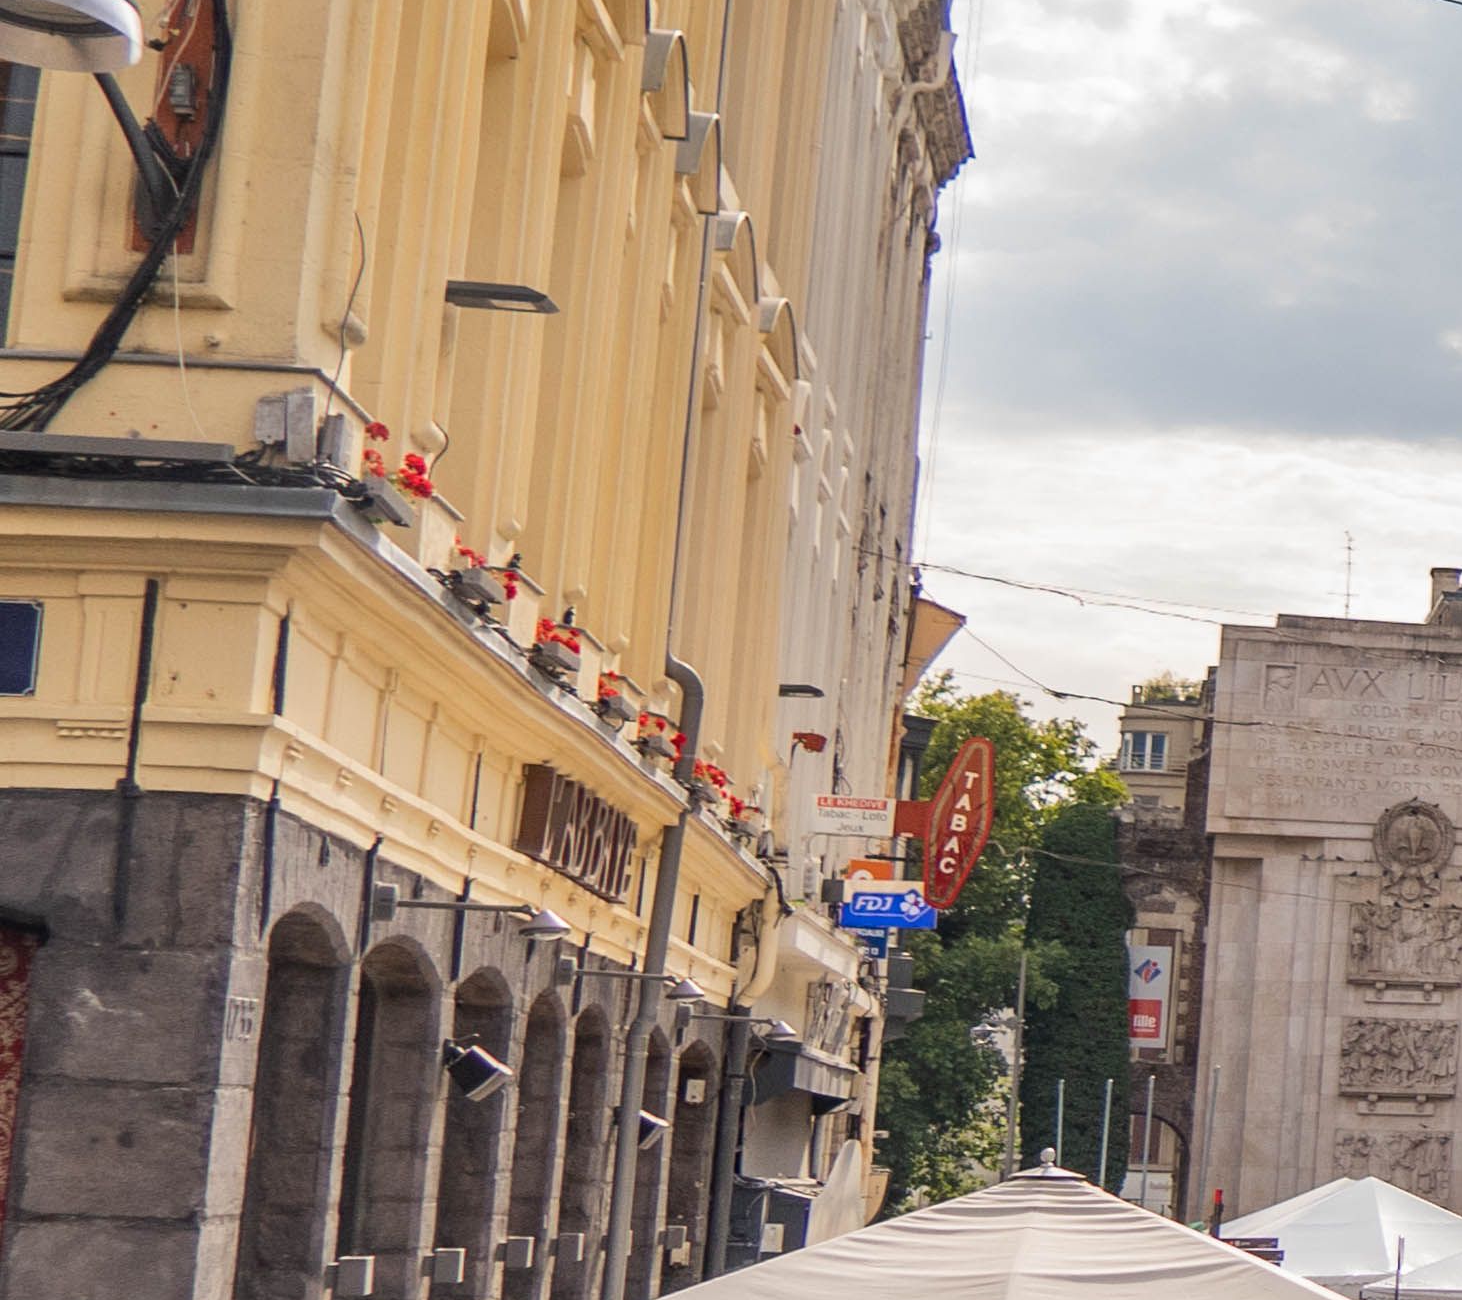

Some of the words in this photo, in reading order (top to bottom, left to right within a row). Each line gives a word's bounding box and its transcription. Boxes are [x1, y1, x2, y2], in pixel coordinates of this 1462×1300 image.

[1306, 668, 1386, 699] AVX
[862, 810, 888, 822] Loto
[939, 771, 980, 874] TABAC
[853, 894, 895, 912] FDJ
